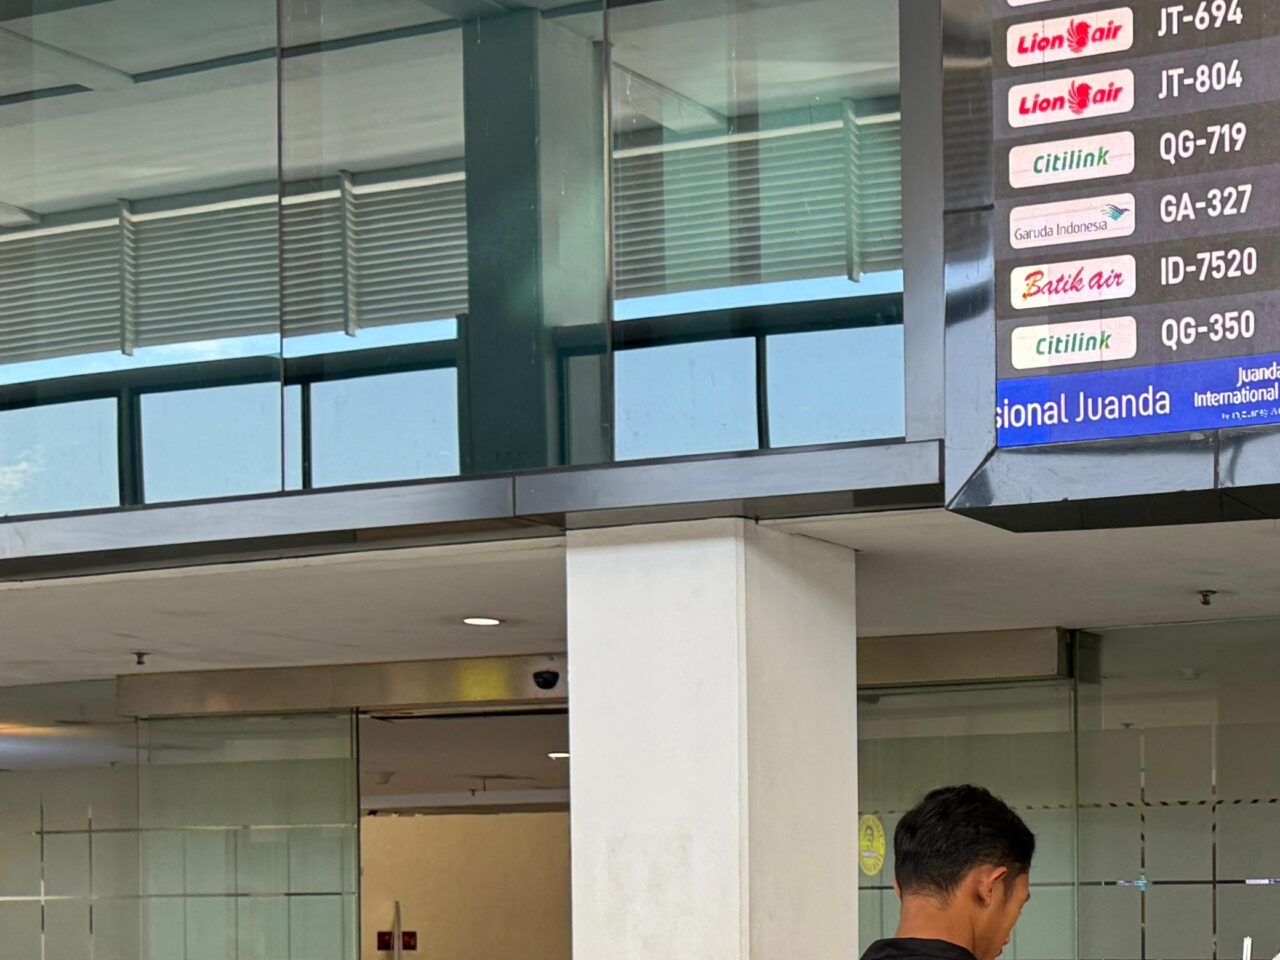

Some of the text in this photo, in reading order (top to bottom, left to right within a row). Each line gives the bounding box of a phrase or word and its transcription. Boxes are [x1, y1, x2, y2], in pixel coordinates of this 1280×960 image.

[1158, 0, 1242, 37] JT-694
[1017, 20, 1122, 55] Lion air
[1158, 59, 1242, 99] JT-804
[1018, 83, 1123, 115] Lion air
[1032, 147, 1109, 174] Citilink
[1159, 122, 1247, 164] QG-719
[1160, 184, 1252, 223] GA-327
[1014, 219, 1108, 241] Garuda Indonesia
[1022, 266, 1084, 300] Batik
[1160, 246, 1257, 285] ID-7520
[1035, 330, 1112, 355] Citilink
[1161, 310, 1255, 350] QG-350
[1075, 385, 1170, 422] Juanda
[1194, 382, 1279, 407] International
